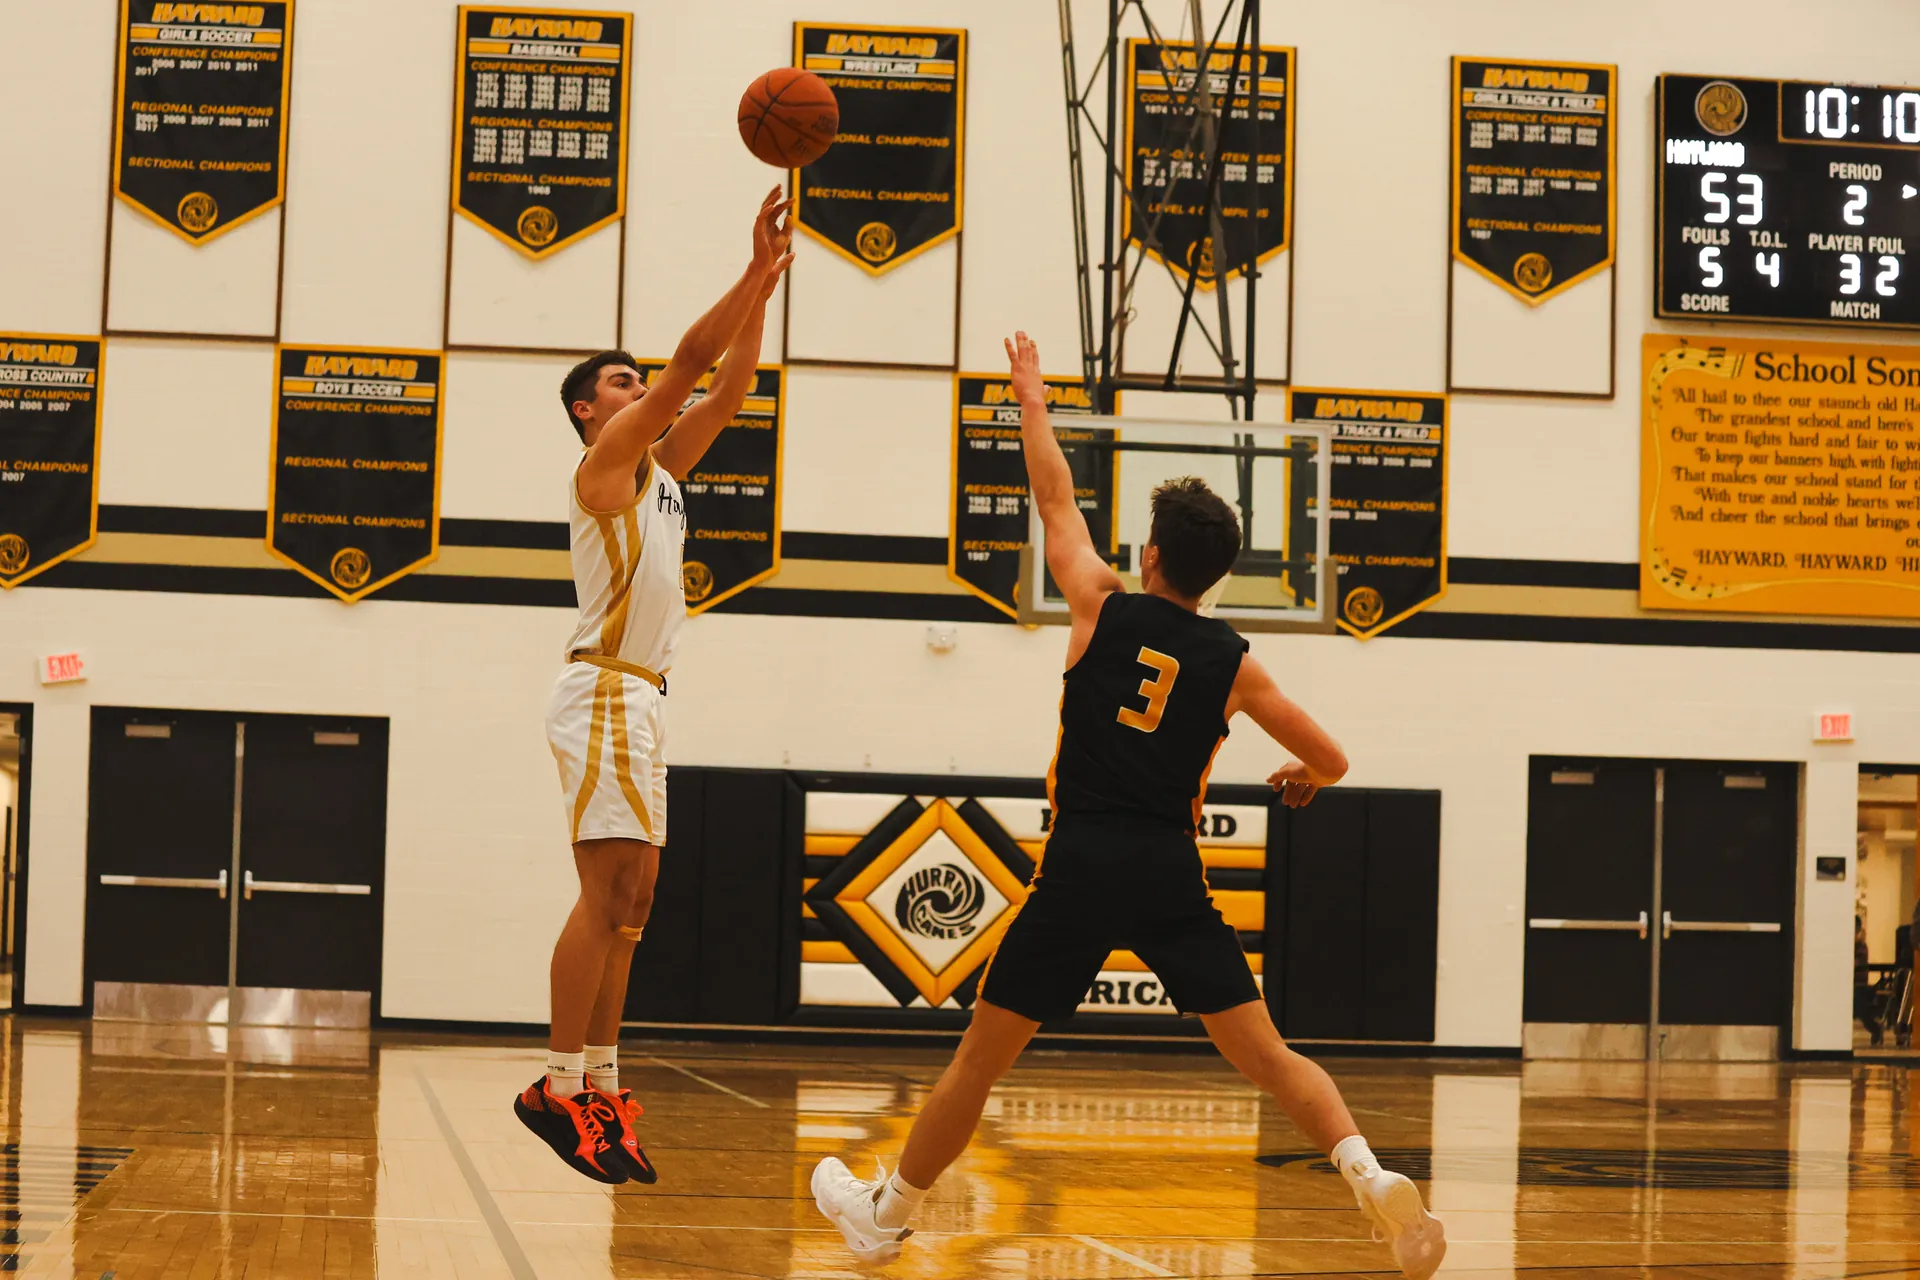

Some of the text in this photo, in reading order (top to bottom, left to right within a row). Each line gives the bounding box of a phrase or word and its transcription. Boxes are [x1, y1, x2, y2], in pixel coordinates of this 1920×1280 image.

[151, 3, 265, 26] HAYWARD
[158, 28, 253, 44] GIRLS SOCCER
[490, 17, 603, 41] HAYWARD
[132, 46, 278, 62] CONFERENCE CHAMPIONS
[510, 44, 578, 58] BASEBALL
[826, 33, 938, 58] HAYWARD
[471, 61, 616, 77] CONFERENCE CHAMPIONS
[844, 60, 917, 74] WRESTLING
[824, 78, 952, 93] NFERENCE CHAMPIONS
[1482, 68, 1589, 93] HAYWARD
[131, 101, 273, 117] REGIONAL CHAMPIONS
[470, 116, 612, 132] REGIONAL CHAMPIONS
[1466, 110, 1603, 127] CONFERENCE CHAMPIONS
[834, 133, 950, 148] IONAL CHAMPIONS
[128, 156, 271, 173] SECTIONAL CHAMPIONS
[1466, 165, 1602, 180] REGIONAL CHAMPIONS
[1829, 162, 1882, 181] PERIOD
[468, 171, 612, 188] SECTIONAL CHAMPIONS
[807, 187, 949, 203] SECTIONAL CHAMPIONS
[1701, 172, 1763, 225] 53
[1843, 184, 1868, 226] 2
[1467, 218, 1602, 235] SECTIONAL CHAMPIONS
[1682, 226, 1788, 248] FOULS T.O.L.
[1808, 233, 1906, 255] PLAYER FOUL
[1699, 246, 1724, 288] 5
[1756, 252, 1780, 288] 4
[1681, 294, 1730, 312] SCORE
[1830, 301, 1880, 320] MATCH
[304, 355, 418, 380] HAYWARD
[1754, 350, 1920, 388] School Son
[30, 370, 86, 384] COUNTRY
[24, 388, 90, 402] CHAMPIONS
[315, 382, 403, 397] BOYS SOCCER
[285, 399, 432, 416] CONFERENCE CHAMPIONS
[1672, 387, 1696, 404] All
[1702, 388, 1727, 405] hail
[1733, 392, 1747, 405] to
[1753, 391, 1781, 407] thee
[1788, 397, 1811, 408] our
[1818, 394, 1870, 410] staunch
[1877, 396, 1898, 412] old
[1315, 398, 1424, 422] HAYWARD
[1695, 407, 1724, 424] The
[1731, 411, 1790, 428] grandest
[1847, 414, 1871, 430] and
[1671, 426, 1899, 450] Our team fights hard and fair to
[1374, 445, 1438, 457] CHAMPIONS
[1716, 448, 1744, 468] keep
[1749, 453, 1769, 465] our
[1774, 450, 1823, 467] banners
[1860, 455, 1885, 470] with
[14, 460, 88, 473] CHAMPIONS
[284, 456, 428, 472] REGIONAL CHAMPIONS
[694, 472, 769, 486] CHAMPIONS
[1671, 466, 1705, 481] That
[1711, 469, 1757, 484] makes
[1764, 474, 1787, 485] our
[1794, 471, 1838, 487] school
[1845, 474, 1882, 489] stand
[1889, 475, 1907, 490] for
[965, 484, 1028, 496] REGIONAL
[1693, 487, 1889, 509] With true and noble hearts
[1364, 499, 1435, 512] CHAMPIONS
[282, 512, 426, 529] SECTIONAL CHAMPIONS
[1670, 504, 1703, 521] And
[1711, 508, 1748, 523] cheer
[1755, 509, 1776, 525] the
[1784, 510, 1828, 527] school
[1834, 512, 1858, 527] that
[1866, 513, 1910, 532] brings
[694, 529, 768, 542] CHAMPIONS
[1365, 555, 1435, 568] CHAMPIONS
[1116, 645, 1180, 733] 3
